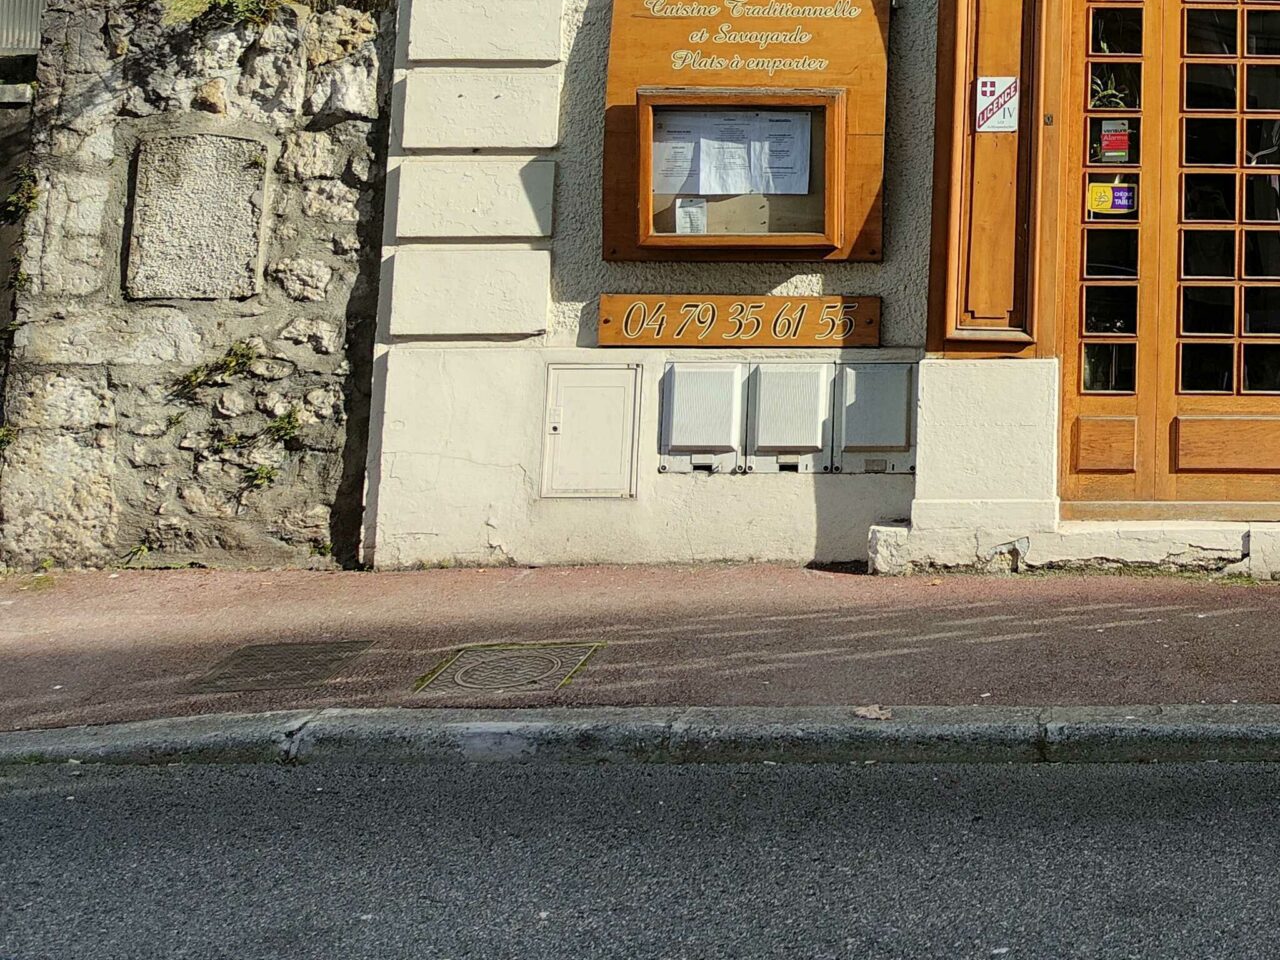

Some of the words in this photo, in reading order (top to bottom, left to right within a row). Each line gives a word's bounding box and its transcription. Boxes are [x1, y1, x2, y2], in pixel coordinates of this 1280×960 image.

[688, 27, 708, 44] et
[712, 23, 812, 49] Savoyarde
[671, 49, 729, 71] Plats
[729, 55, 743, 70] à
[746, 57, 828, 77] emporter
[979, 82, 1017, 126] LICENCE
[1002, 106, 1016, 120] IV
[622, 301, 667, 339] 04
[673, 302, 718, 339] 79
[722, 302, 765, 340] 35
[771, 302, 807, 340] 61
[815, 302, 858, 340] 55
